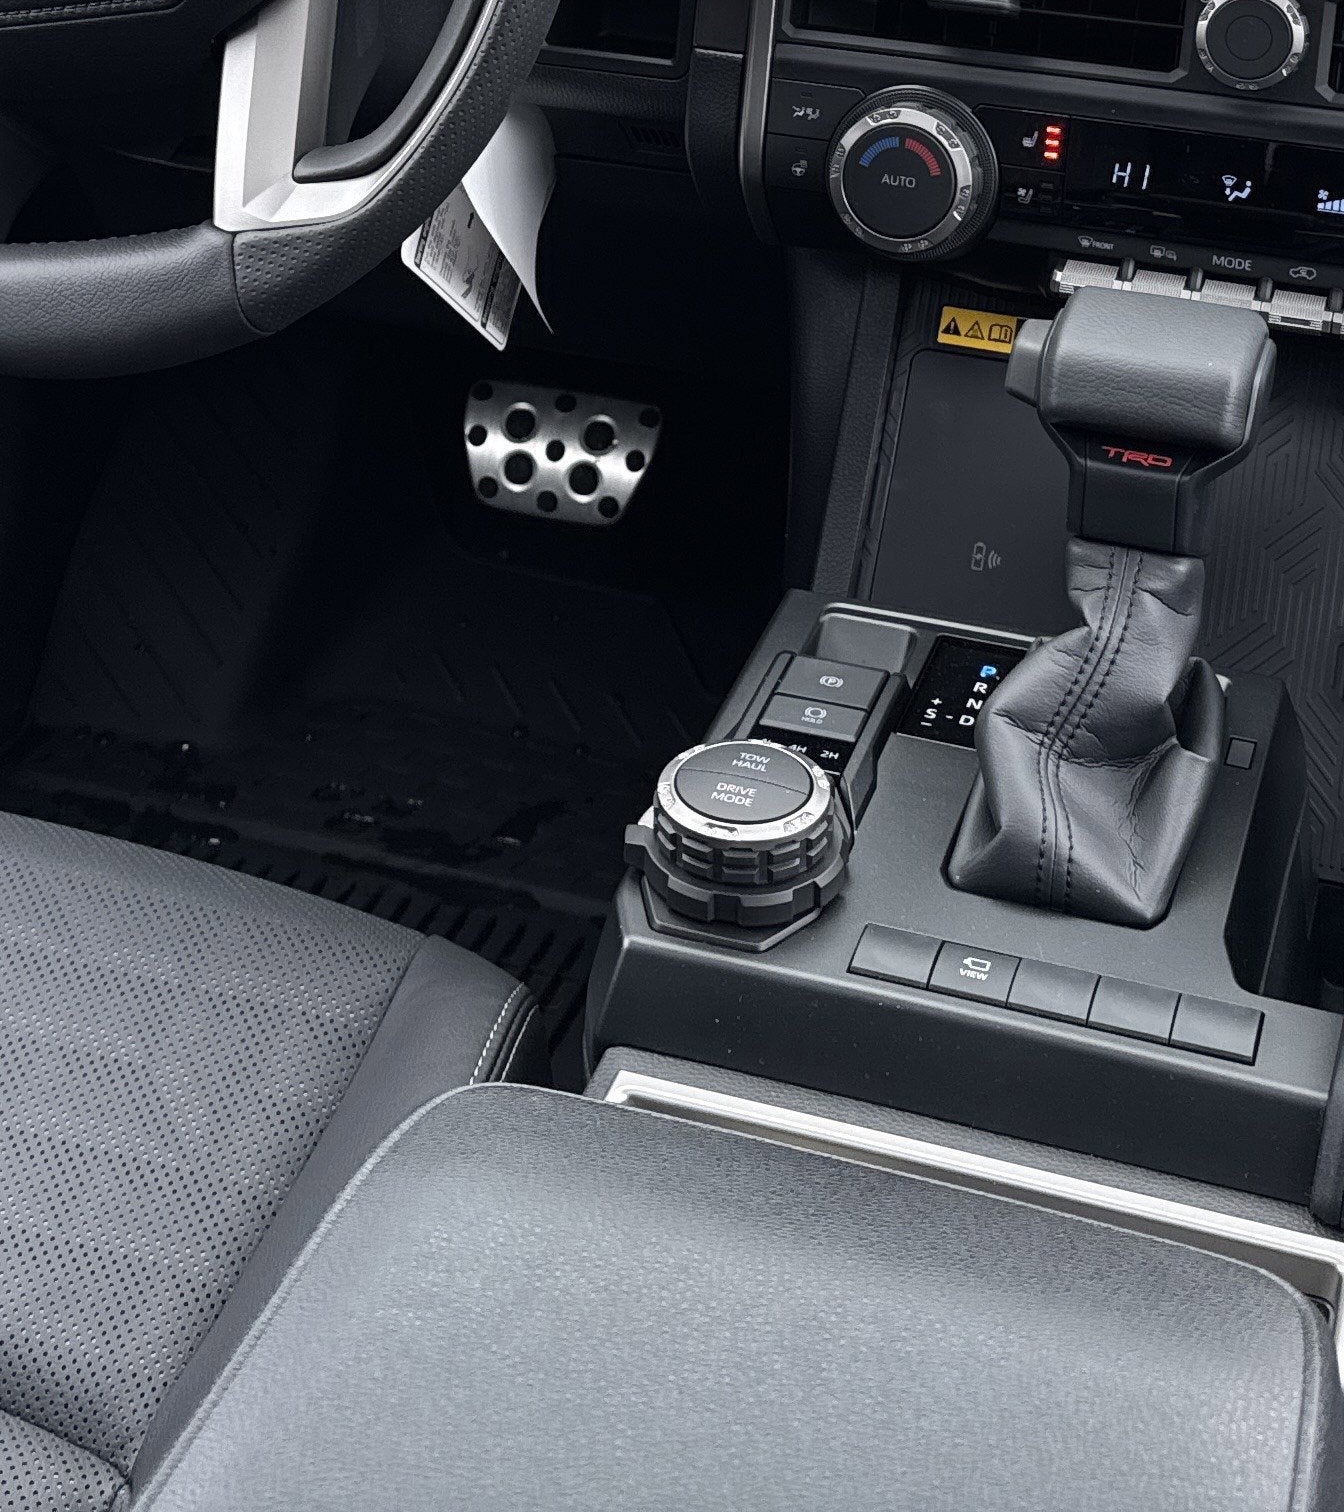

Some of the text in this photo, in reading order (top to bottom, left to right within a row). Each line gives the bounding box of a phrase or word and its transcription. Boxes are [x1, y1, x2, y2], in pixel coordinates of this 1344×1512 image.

[880, 173, 916, 188] AUTO
[1112, 162, 1150, 190] HI
[1092, 240, 1114, 250] FRONT
[1211, 254, 1252, 271] MODE
[1101, 445, 1173, 467] TRD
[980, 665, 997, 678] P
[973, 681, 988, 694] R
[966, 698, 983, 710] N
[924, 708, 975, 726] S D
[739, 752, 771, 764] TOW
[820, 750, 839, 760] 2H
[732, 759, 768, 773] HAUL
[716, 782, 757, 798] DRIVE
[710, 791, 754, 807] MODE
[959, 967, 989, 981] VIEW
